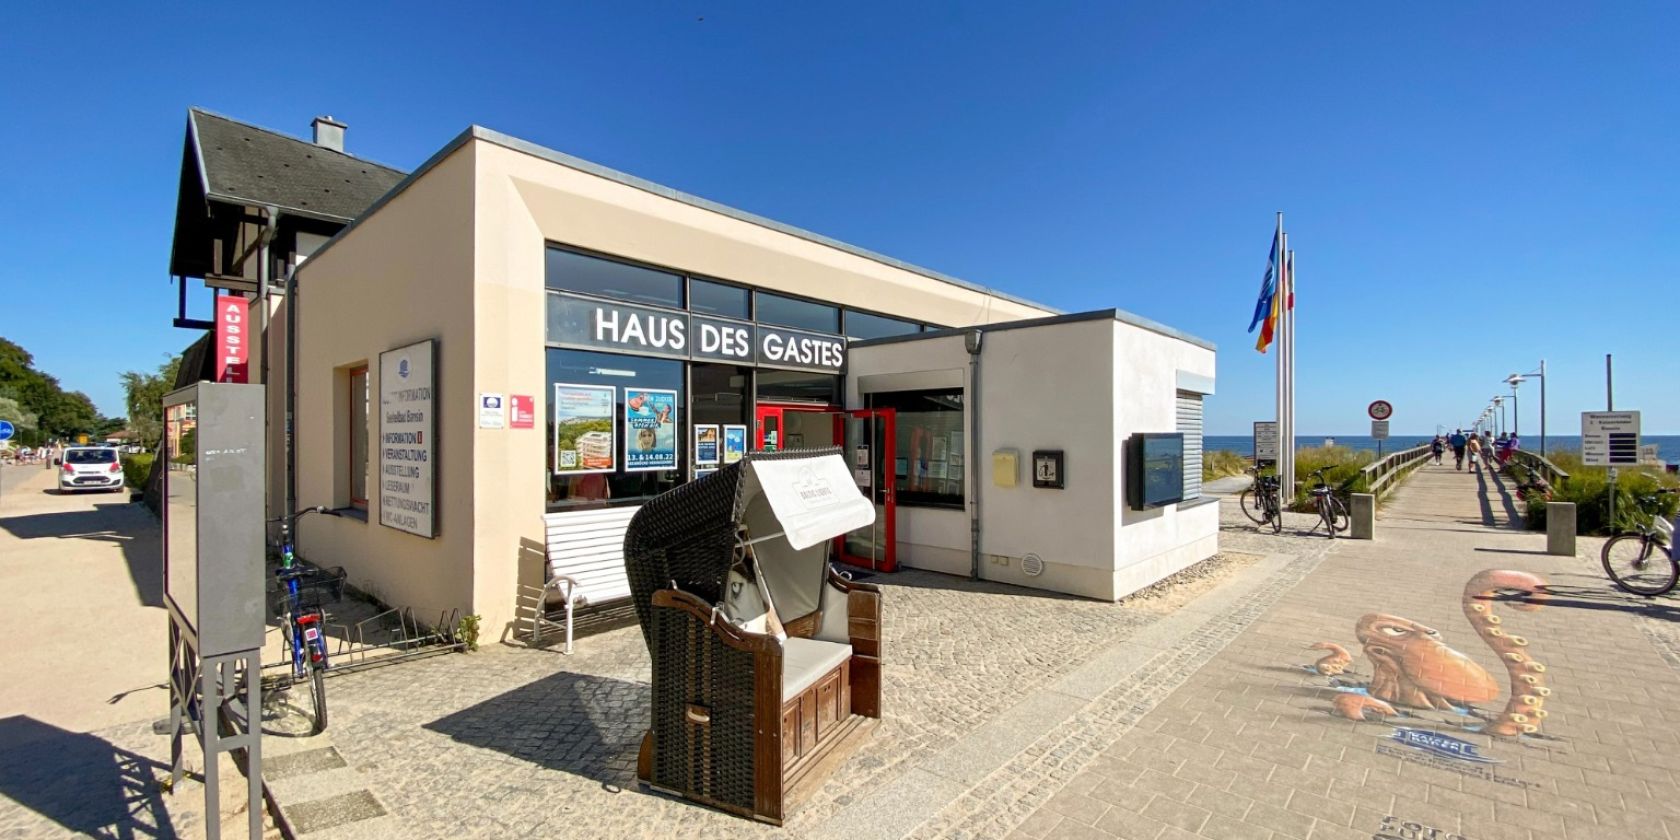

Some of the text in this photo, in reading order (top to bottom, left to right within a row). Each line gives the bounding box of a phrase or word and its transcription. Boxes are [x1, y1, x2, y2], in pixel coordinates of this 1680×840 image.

[596, 308, 843, 367] HAUS DES GASTES
[385, 432, 416, 444] INFORMATION
[385, 449, 427, 462] VERANSTALTUNG
[385, 465, 419, 478] AUSSTELLUNG
